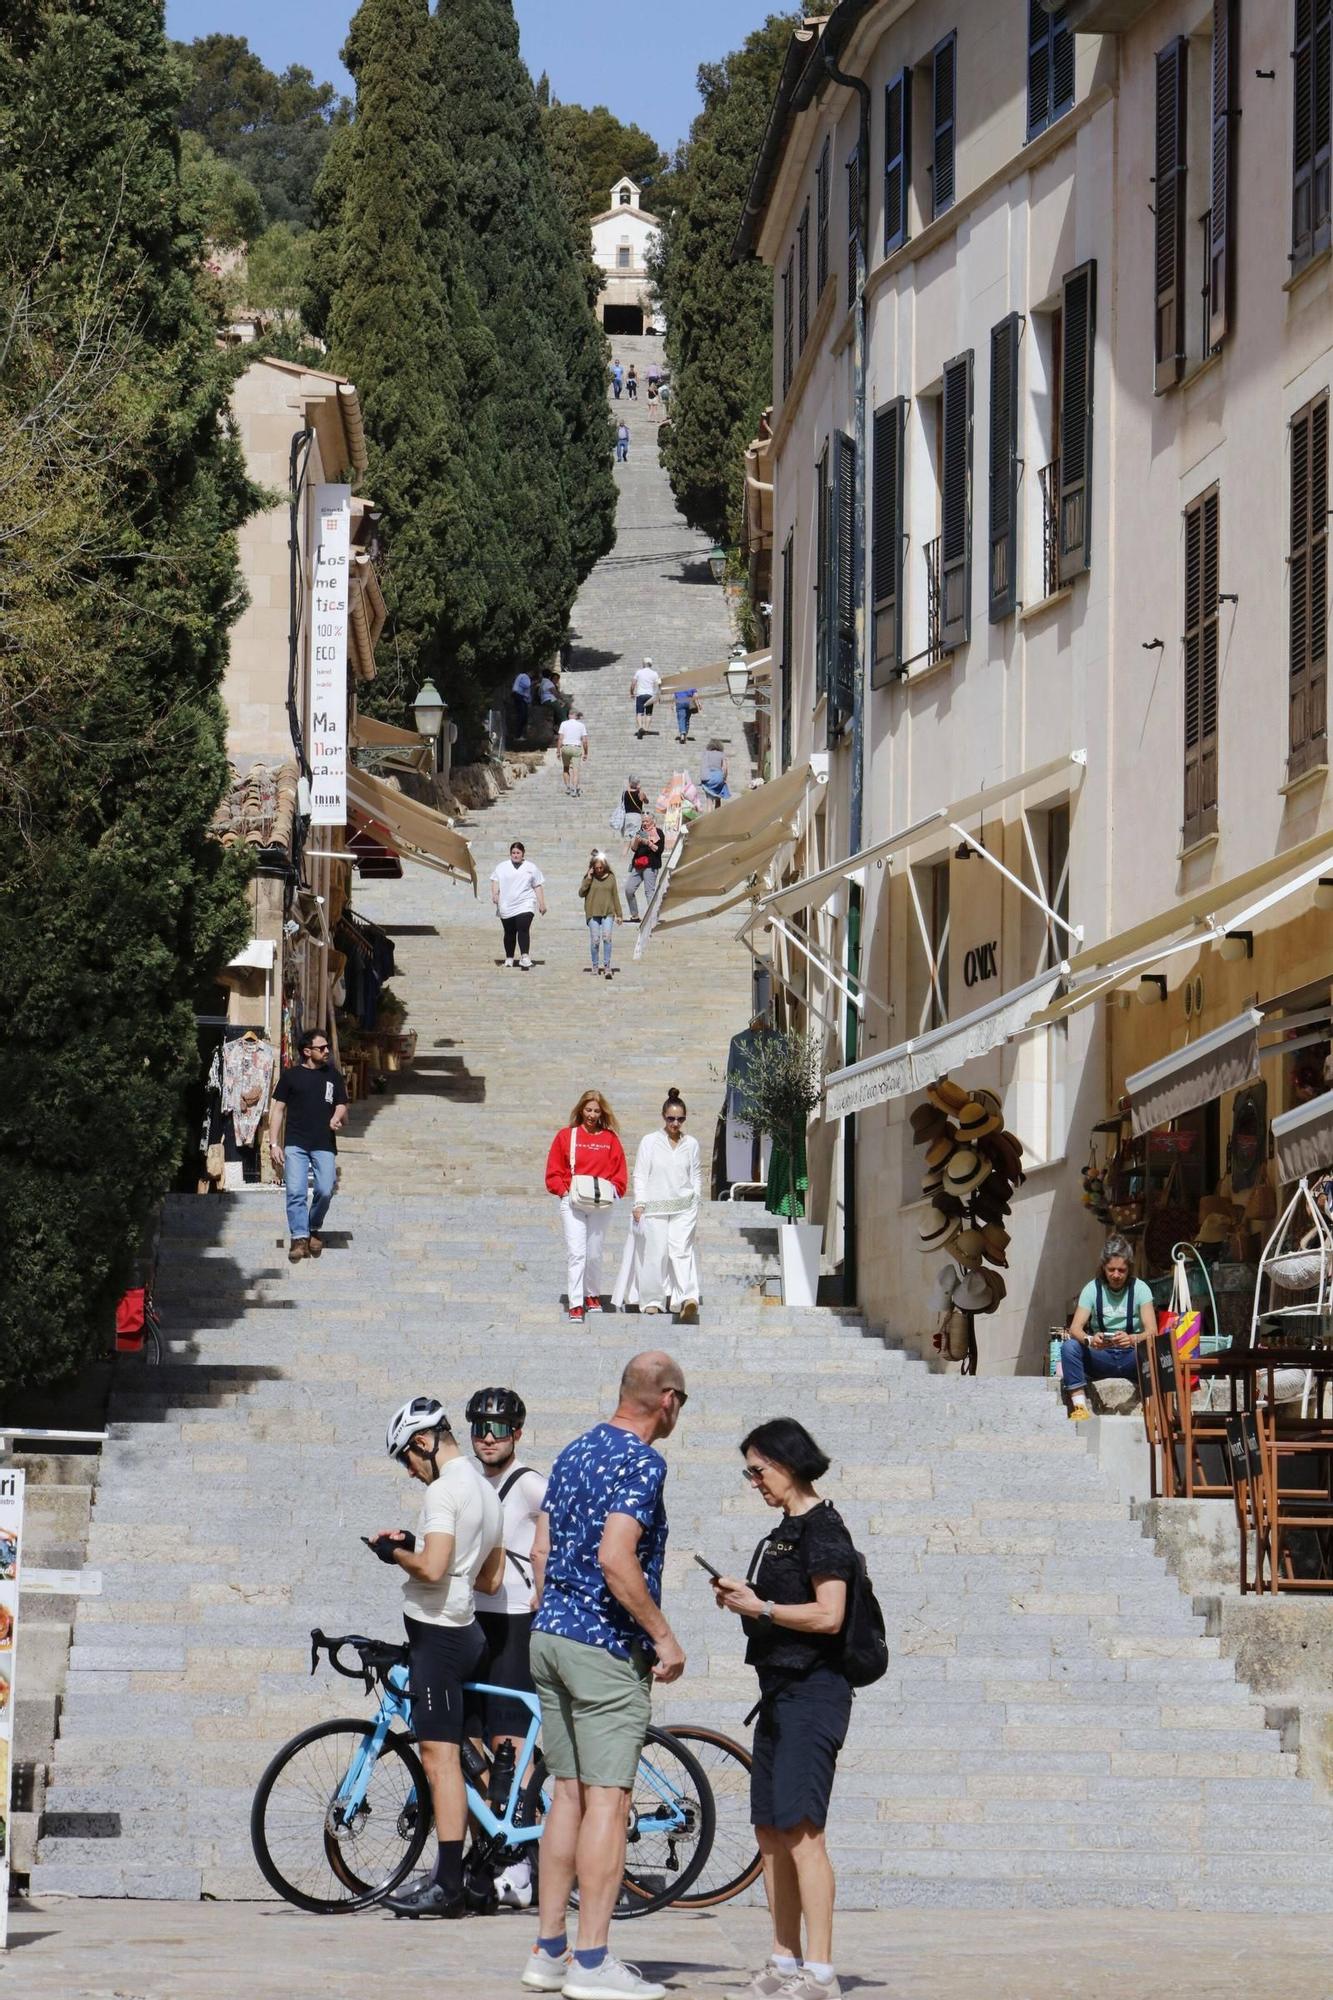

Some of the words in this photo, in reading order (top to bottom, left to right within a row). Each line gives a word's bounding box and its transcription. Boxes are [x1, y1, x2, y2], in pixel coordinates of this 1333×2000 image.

[316, 578, 337, 588] me
[316, 597, 345, 612] tics
[315, 646, 336, 660] ECO
[313, 712, 336, 732] Ma
